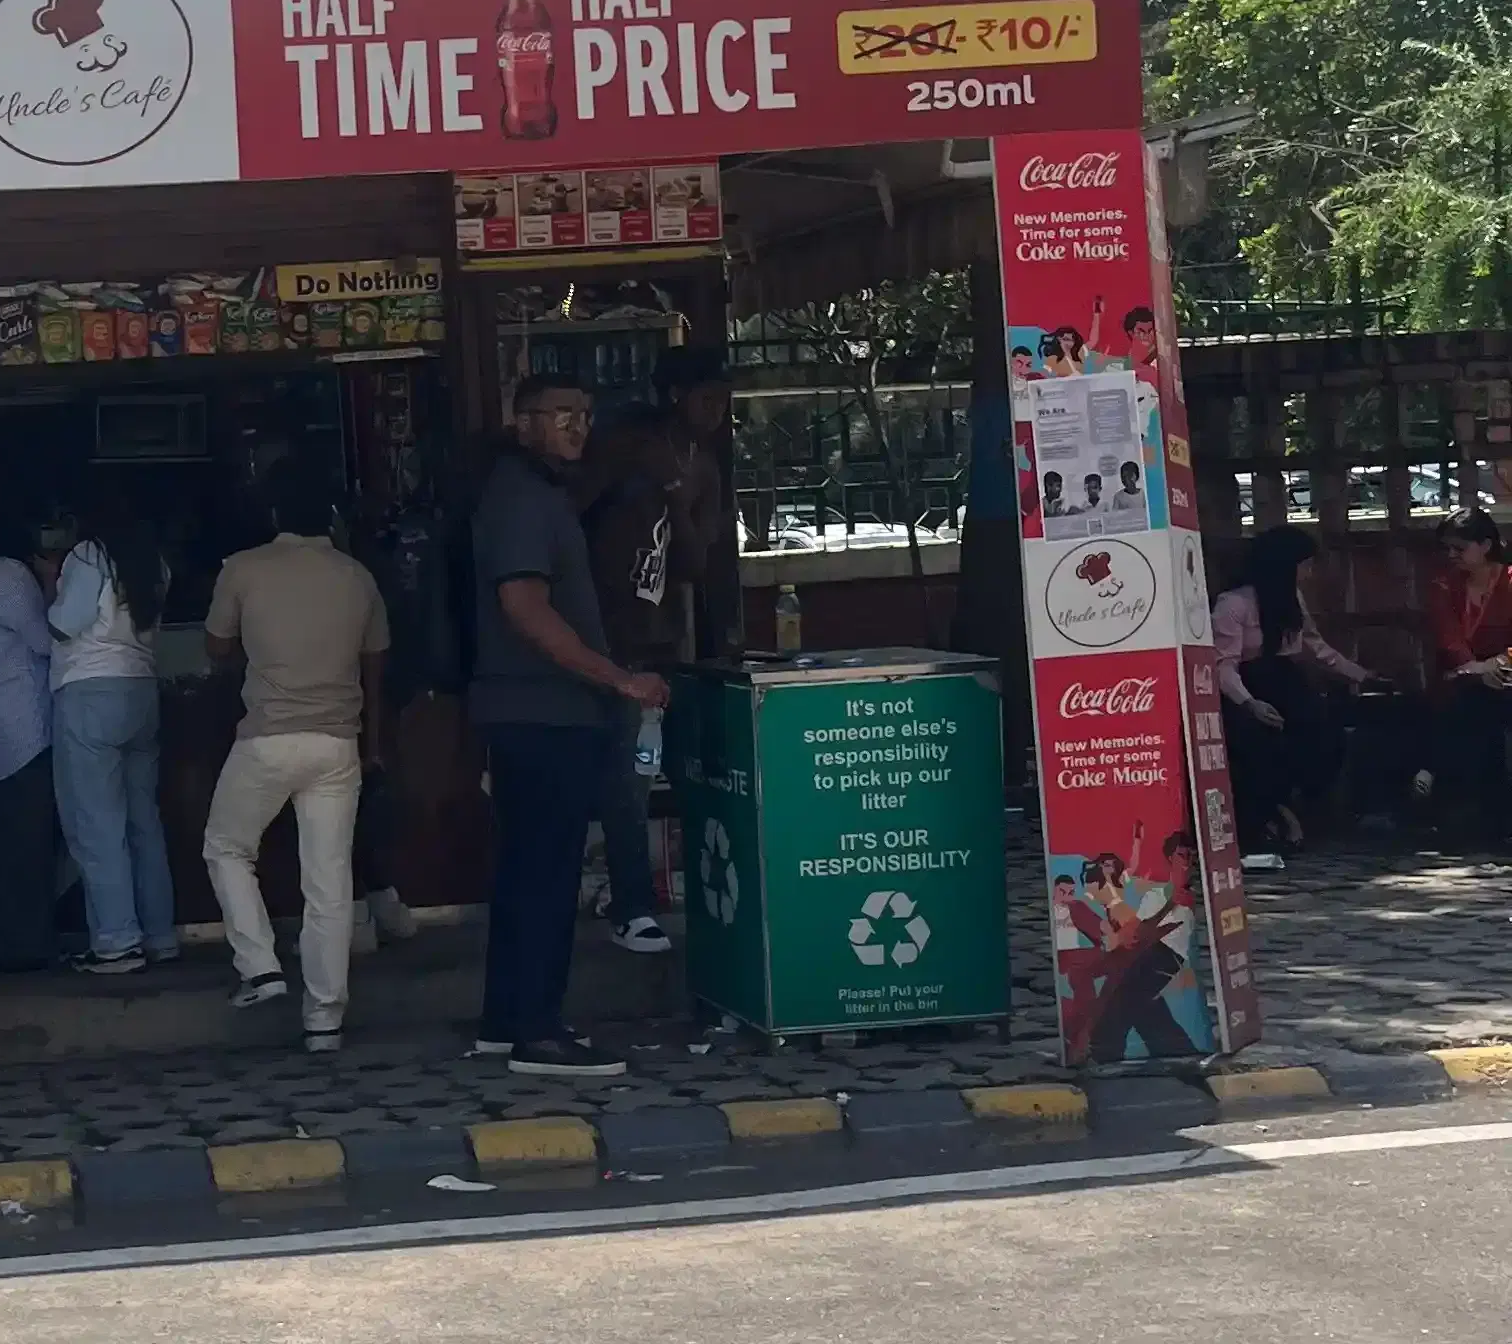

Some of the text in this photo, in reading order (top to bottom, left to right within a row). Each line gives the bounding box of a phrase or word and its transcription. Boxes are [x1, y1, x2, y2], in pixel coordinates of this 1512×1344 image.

[573, 17, 796, 120] PRICE
[101, 76, 172, 117] Café
[284, 38, 483, 138] TIME
[907, 74, 1035, 111] 250ml
[1020, 152, 1121, 191] Coca-Cola
[1014, 213, 1047, 225] New
[1020, 225, 1123, 240] Time for some
[1016, 237, 1129, 261] Coke Magic
[296, 270, 438, 295] Do Nothing
[846, 697, 914, 716] It's not
[1059, 677, 1158, 718] Coca-Cola
[804, 718, 957, 744] someone else's
[814, 743, 949, 768] responsibility
[1054, 741, 1087, 753] New
[1061, 750, 1161, 768] Time for some
[814, 768, 951, 791] to pick up our
[1057, 762, 1168, 789] Coke Magic
[862, 793, 906, 810] litter
[840, 829, 929, 851] IT'S OUR
[799, 849, 971, 877] RESPONSIBILITY
[914, 984, 944, 997] your
